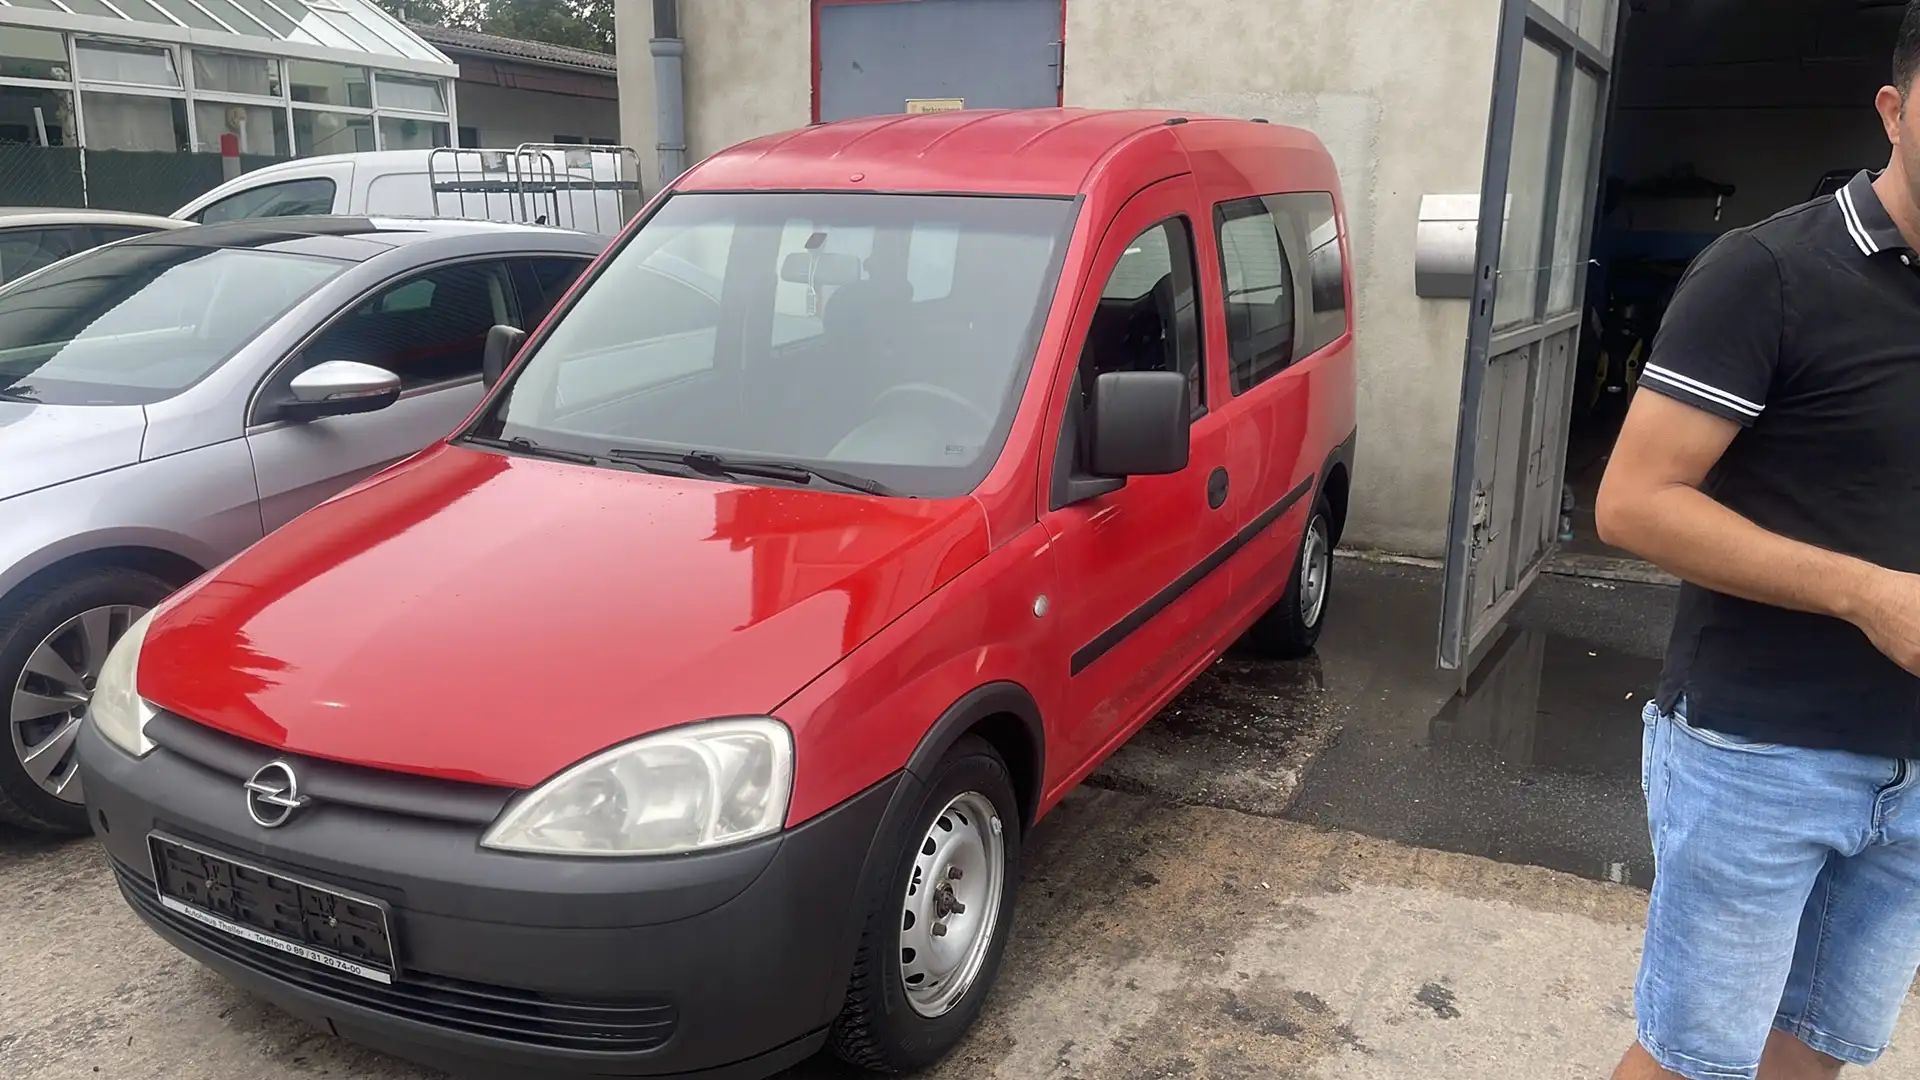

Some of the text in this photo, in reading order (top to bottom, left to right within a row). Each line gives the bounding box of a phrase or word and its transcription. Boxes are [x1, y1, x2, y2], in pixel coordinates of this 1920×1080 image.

[184, 907, 217, 926] Autohaus
[255, 934, 285, 948] Telefon
[311, 952, 321, 961] 31
[324, 956, 335, 966] 20
